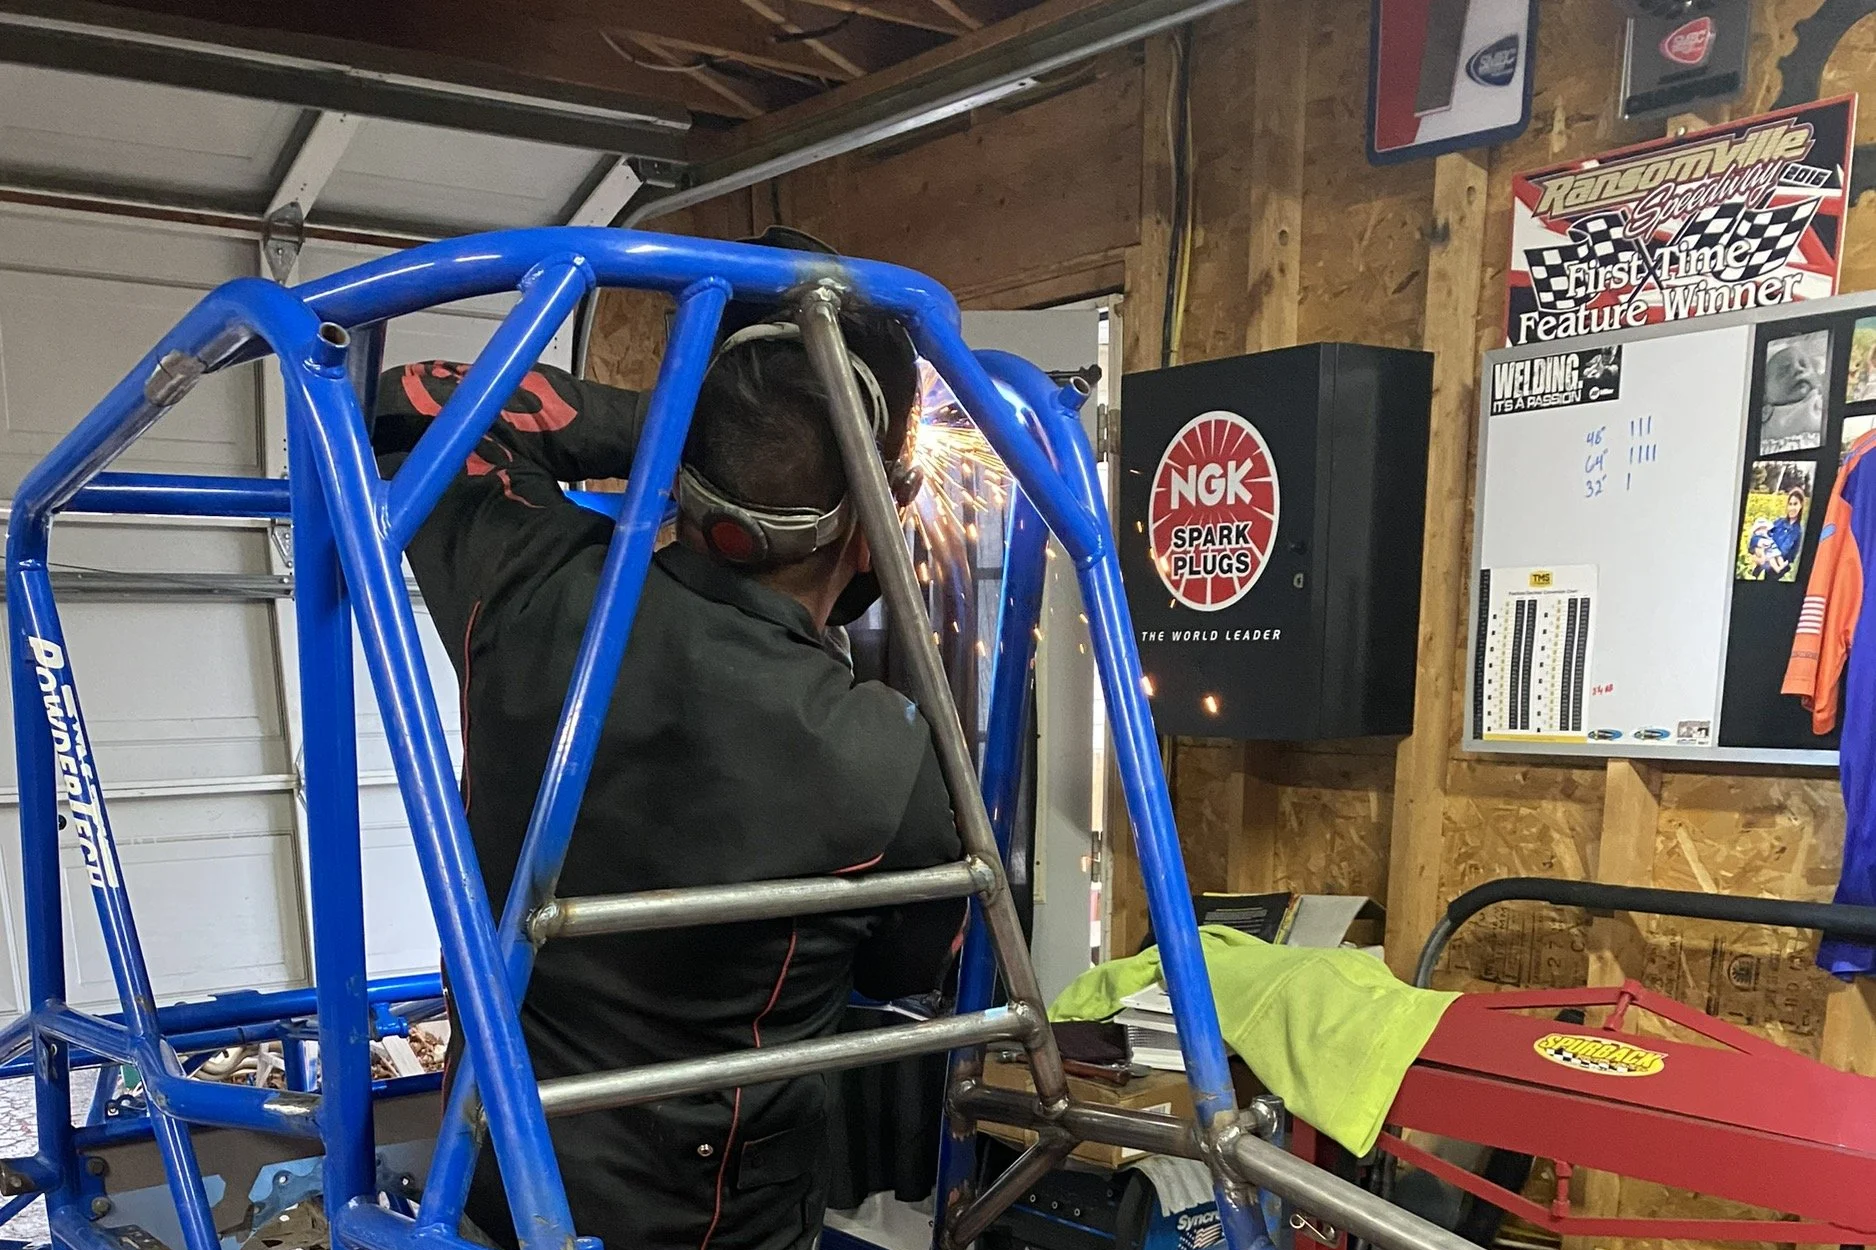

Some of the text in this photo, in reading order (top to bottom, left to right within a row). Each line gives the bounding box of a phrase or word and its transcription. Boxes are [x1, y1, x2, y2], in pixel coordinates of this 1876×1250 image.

[1624, 161, 1781, 237] Speedway
[1566, 239, 1751, 298] First Time
[1519, 272, 1804, 345] Feature Winner
[1515, 399, 1525, 410] A
[1527, 390, 1581, 409] PASSION
[1170, 457, 1254, 510] NGK
[1172, 522, 1251, 549] SPARK
[1172, 551, 1251, 577] PLUGS
[1532, 573, 1551, 582] TMS
[1142, 629, 1282, 642] THE WORLD LEADER
[1538, 1035, 1662, 1069] SPURBACK
